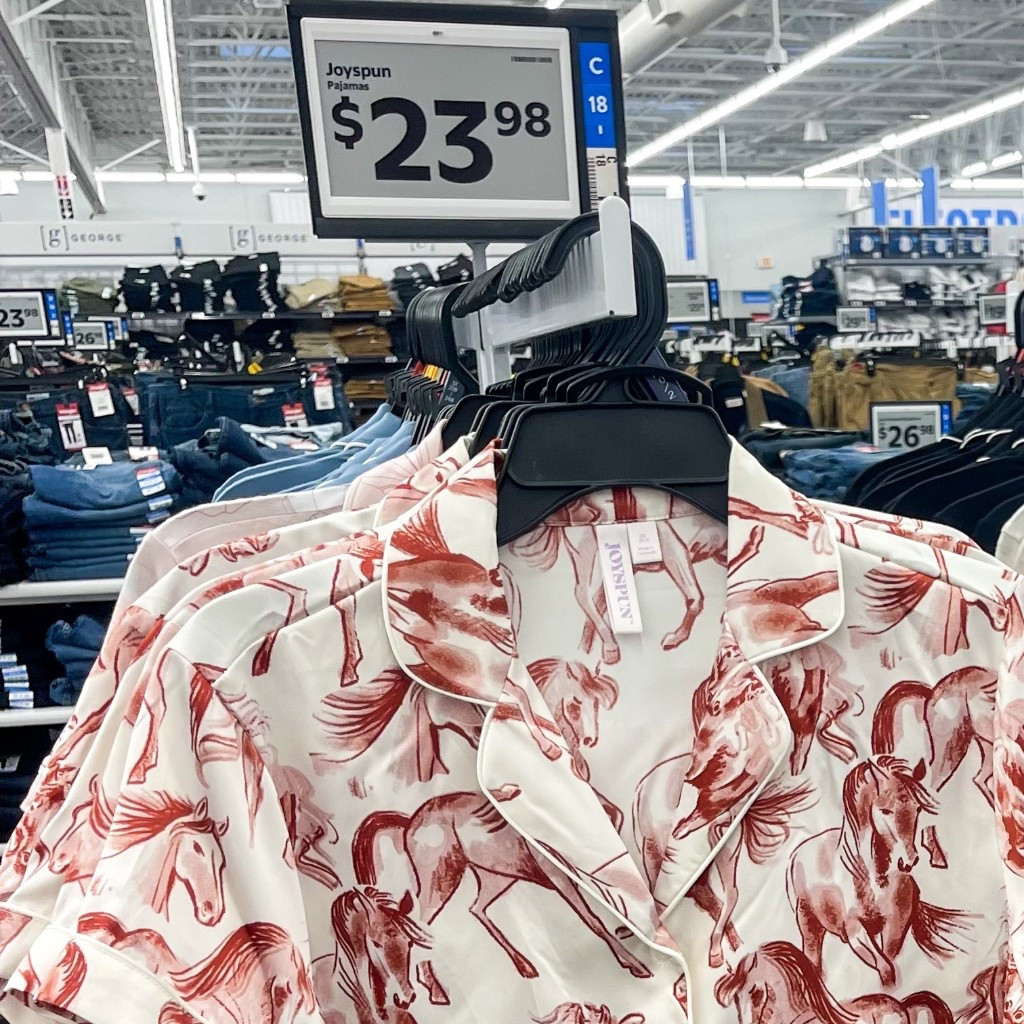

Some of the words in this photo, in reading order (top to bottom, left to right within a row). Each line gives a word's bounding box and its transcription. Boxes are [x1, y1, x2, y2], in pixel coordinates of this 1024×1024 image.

[326, 62, 392, 80] Joyspun
[588, 57, 604, 75] C
[327, 81, 370, 92] Pajamas
[588, 95, 608, 113] 18
[71, 233, 123, 242] GEORGE
[258, 233, 307, 243] GEORGE
[604, 543, 633, 620] JOYSPUN
